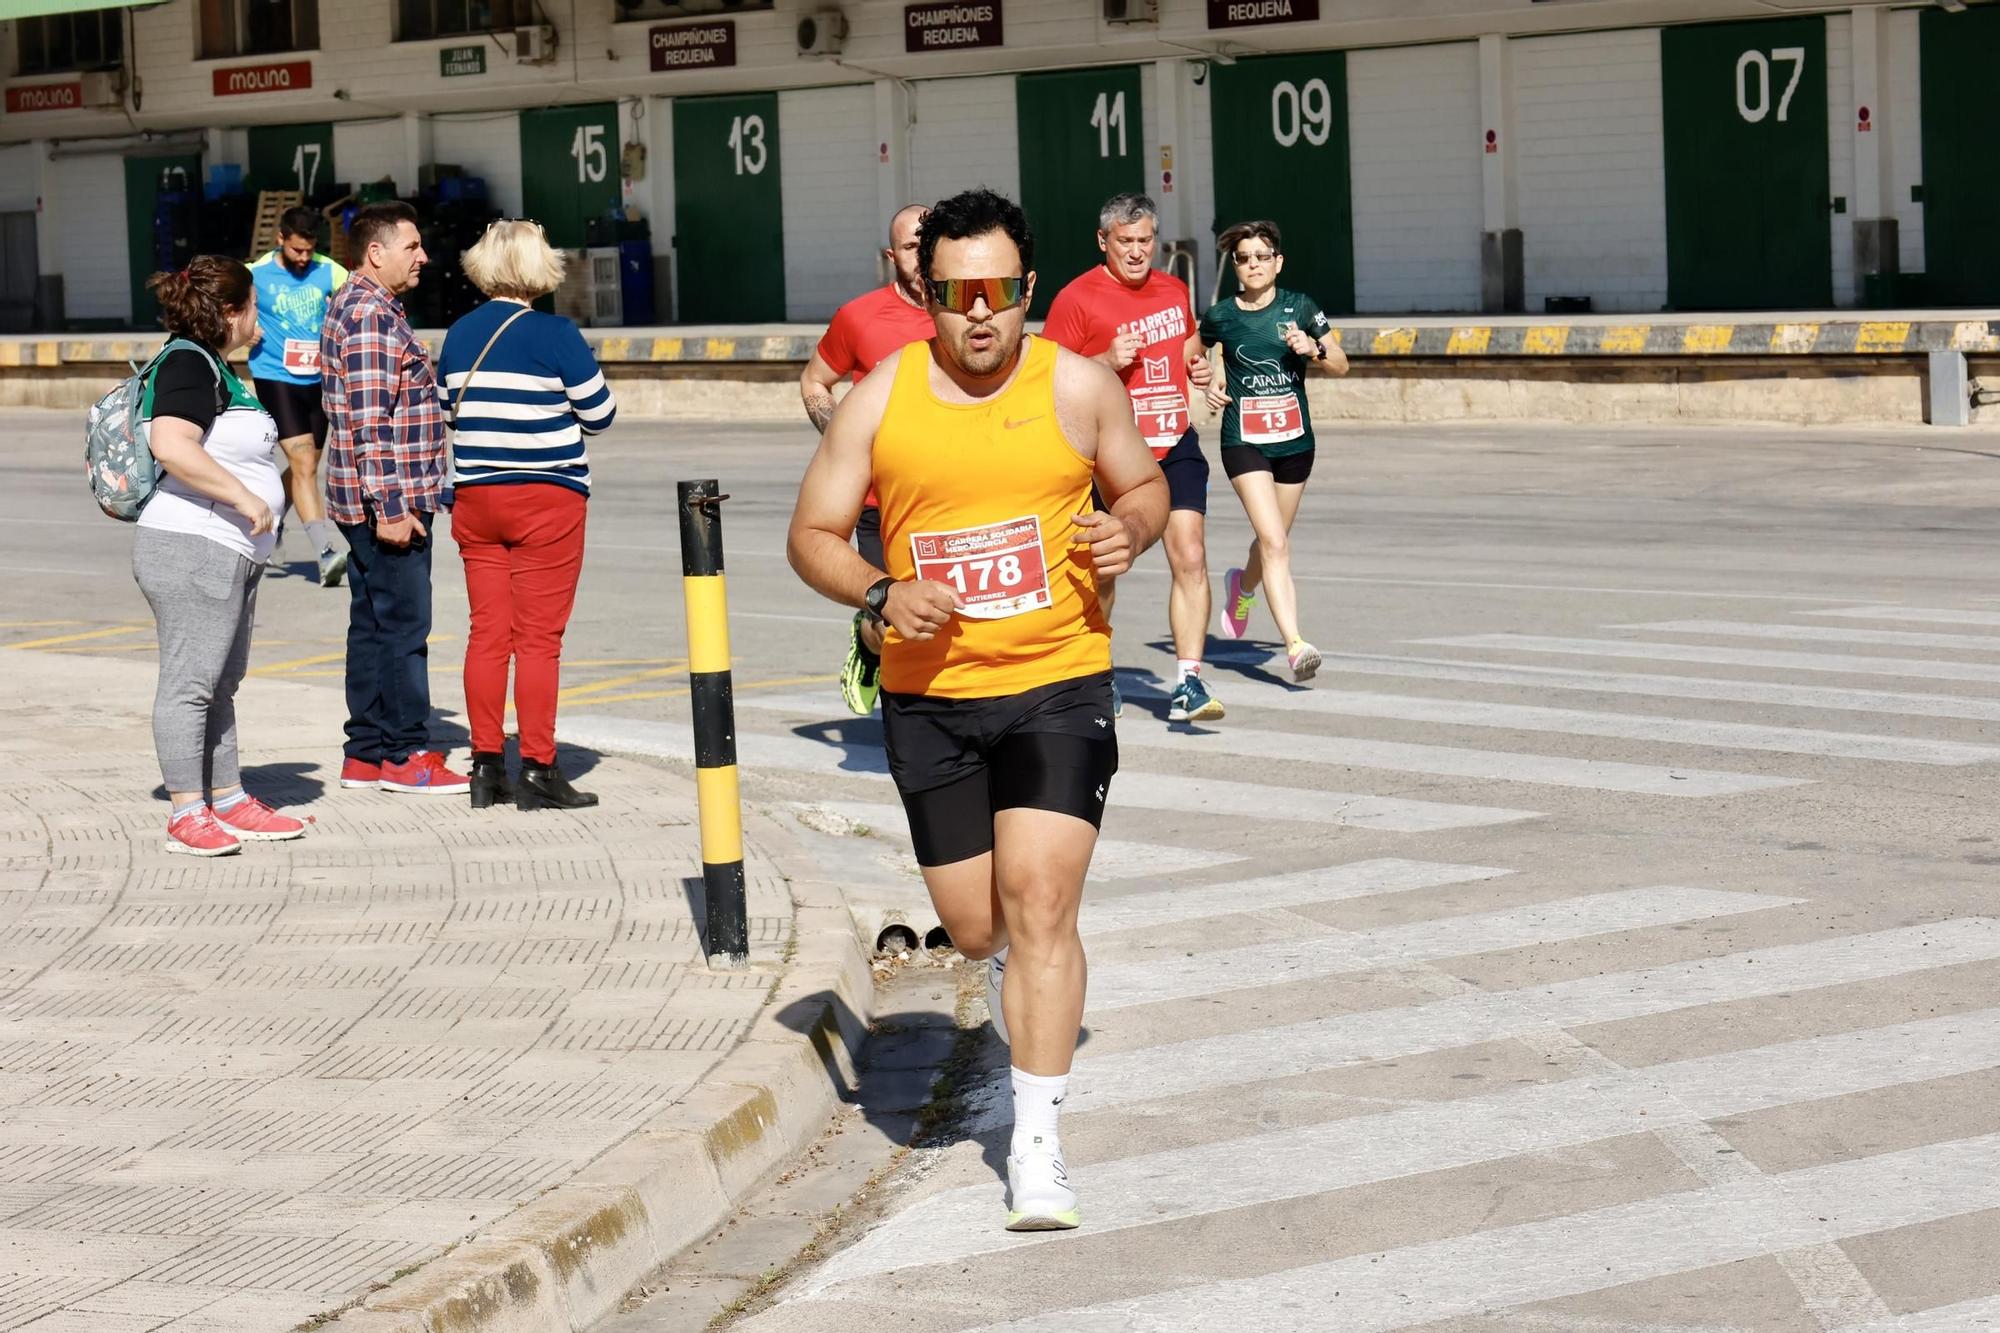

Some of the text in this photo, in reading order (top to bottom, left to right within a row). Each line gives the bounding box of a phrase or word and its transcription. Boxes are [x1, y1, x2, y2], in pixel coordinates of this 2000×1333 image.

[909, 5, 993, 27] CHAMPIÑONES
[1228, 0, 1293, 20] REQUENA
[653, 28, 727, 48] CHAMPIÑONES
[923, 27, 979, 45] REQUENA
[666, 48, 715, 64] REQUENA
[1736, 46, 1805, 123] 07
[1272, 78, 1332, 147] 09
[1090, 91, 1127, 157] 11
[570, 125, 607, 183] 15
[727, 114, 767, 175] 13
[292, 144, 321, 196] 17
[1130, 305, 1184, 335] CARRERA
[1146, 321, 1186, 346] IDARIA
[298, 352, 318, 365] 47
[1242, 370, 1300, 388] CATALINA
[1156, 412, 1178, 432] 14
[1262, 411, 1288, 429] 13
[990, 523, 1035, 540] SOLIDARIA
[946, 554, 1023, 594] 178
[965, 591, 1007, 602] GUTIERREZ
